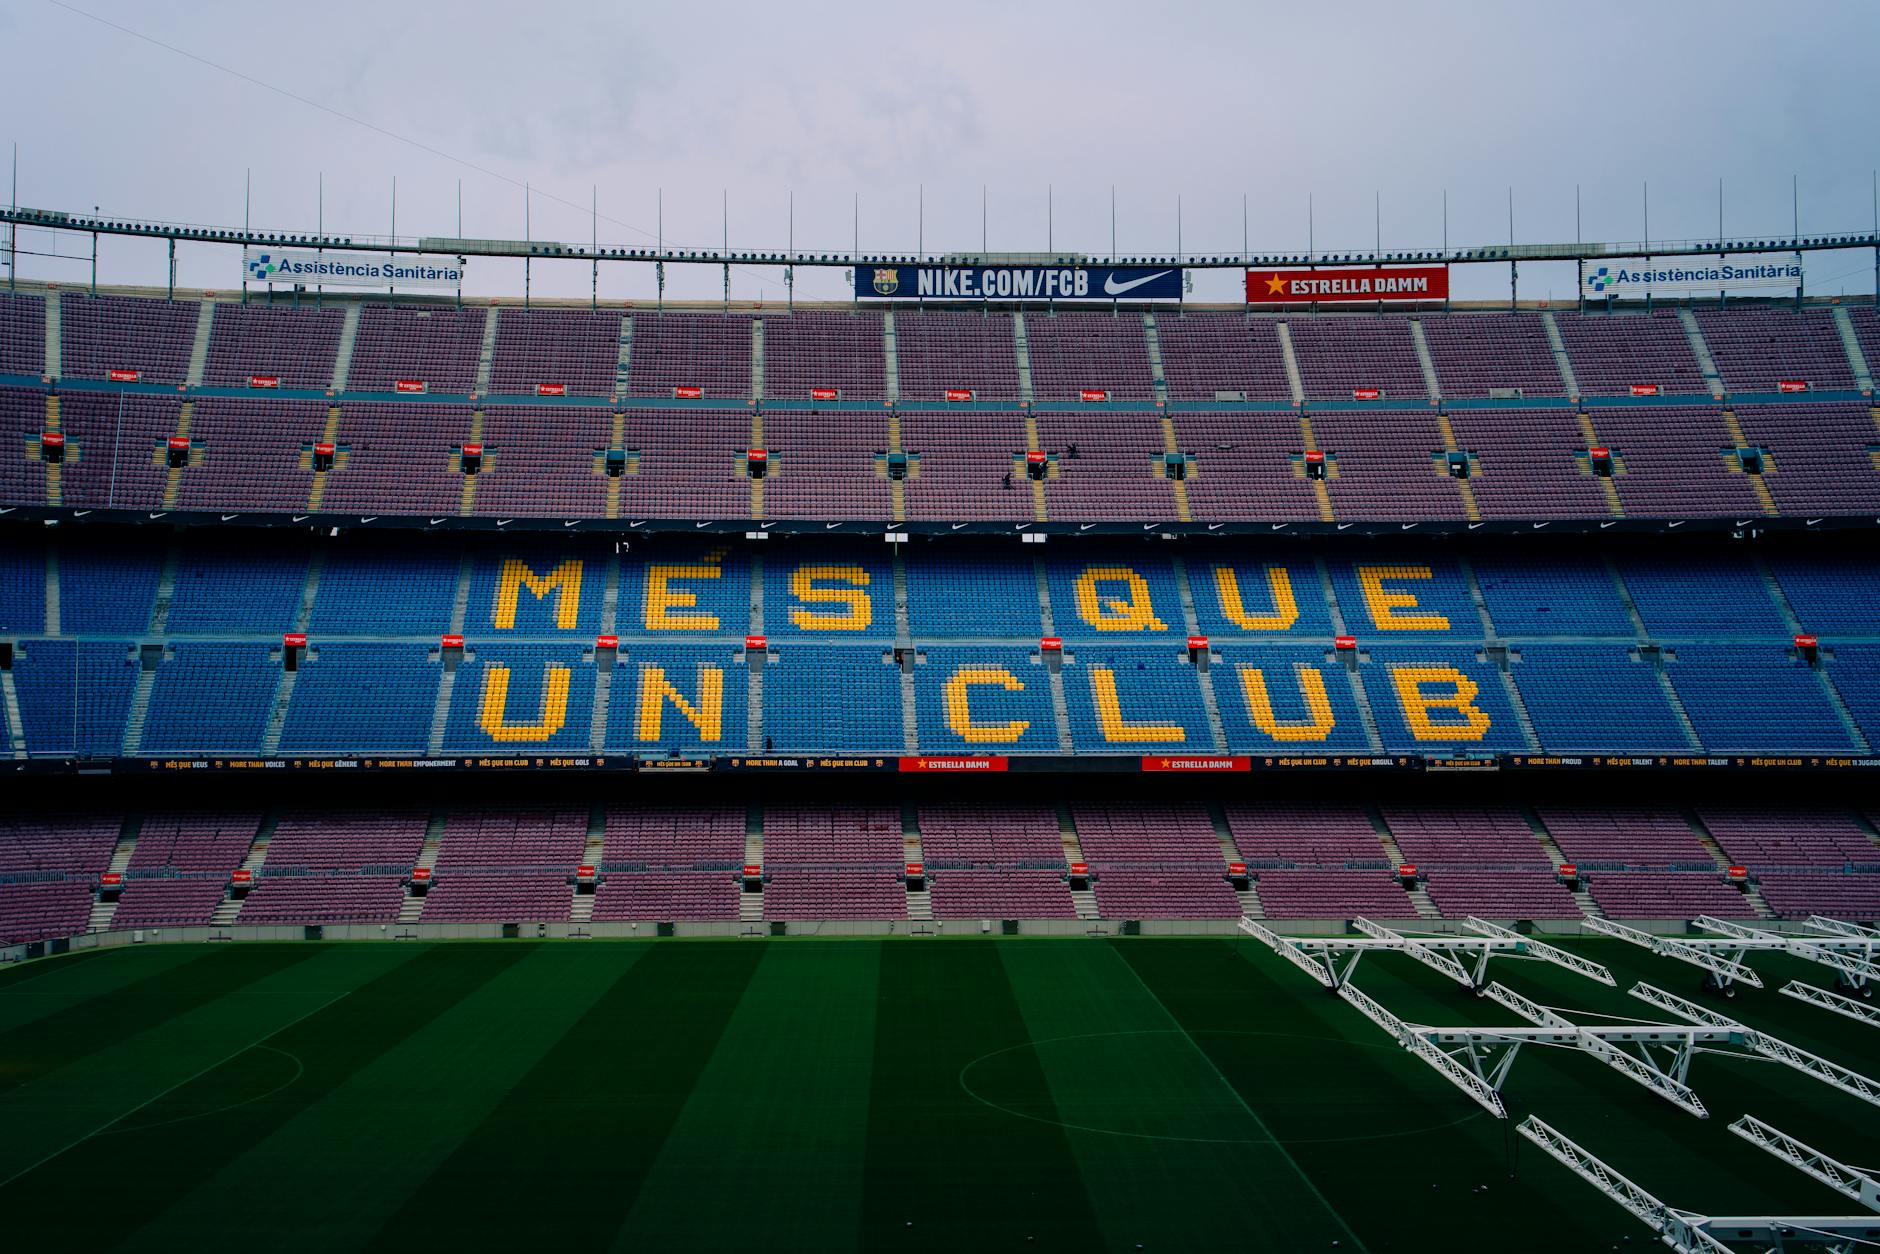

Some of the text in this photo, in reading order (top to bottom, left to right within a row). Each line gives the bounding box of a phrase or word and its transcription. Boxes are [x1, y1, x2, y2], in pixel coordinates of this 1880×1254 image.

[278, 258, 458, 280] Assistència Sanitària
[1617, 264, 1801, 283] Assistència Sanitària
[918, 269, 1089, 296] NIKE.COM/FCB
[1291, 277, 1428, 295] ESTRELLA DAMM
[1074, 566, 1450, 631] QUE
[478, 663, 1491, 743] UN CLUB
[192, 761, 208, 769] VEUS
[783, 759, 799, 767] GOAL
[928, 761, 990, 769] ESTRELLA DAMM
[1171, 760, 1233, 769] ESTRELLA DAMM
[1707, 758, 1728, 766] TALENT
